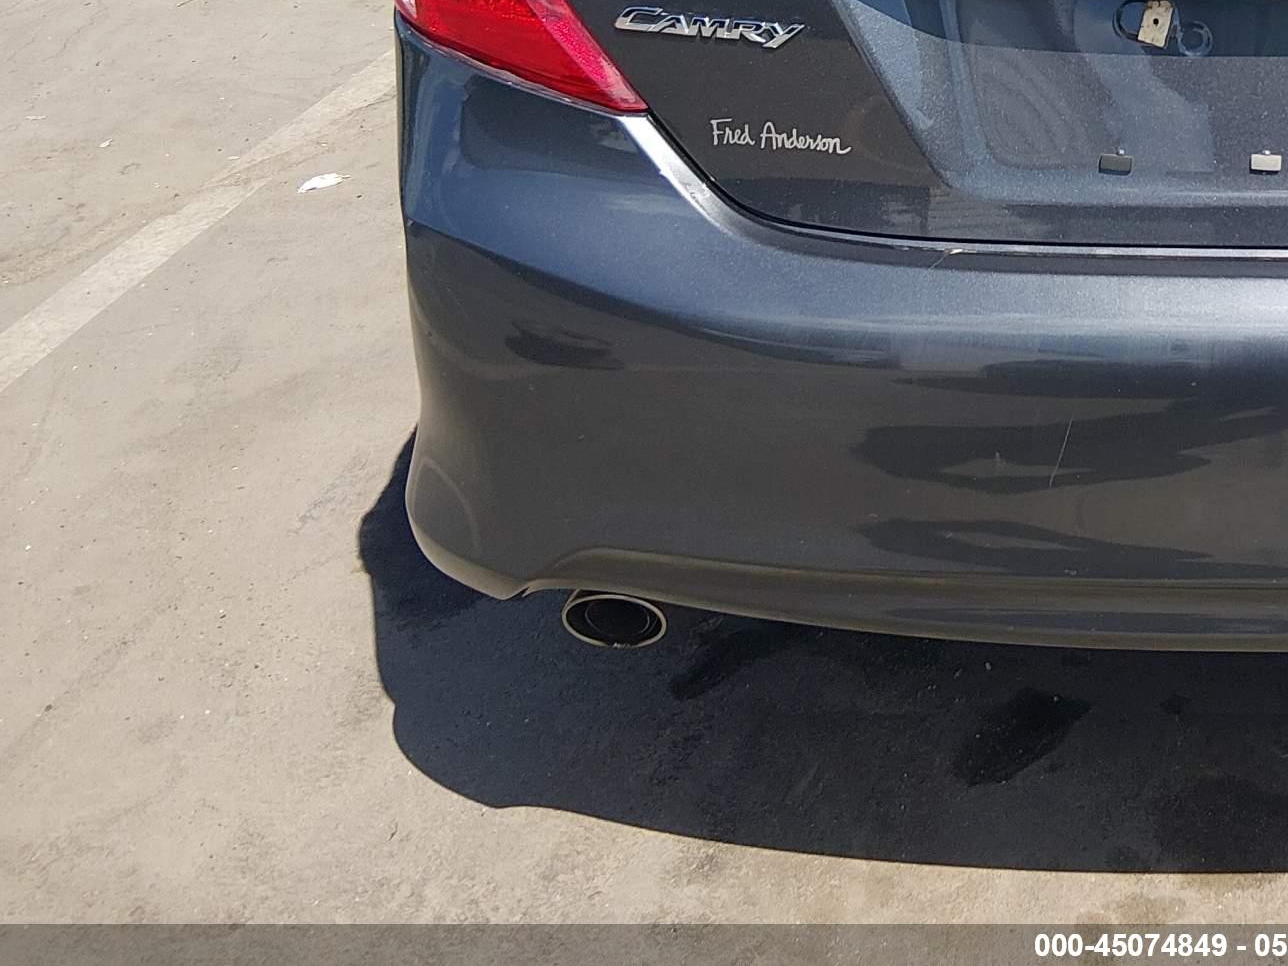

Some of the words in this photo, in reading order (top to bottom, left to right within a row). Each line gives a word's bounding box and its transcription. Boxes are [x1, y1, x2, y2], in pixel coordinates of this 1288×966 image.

[614, 6, 804, 48] CAMRY
[710, 118, 755, 146] Fred
[760, 121, 851, 155] Anderson
